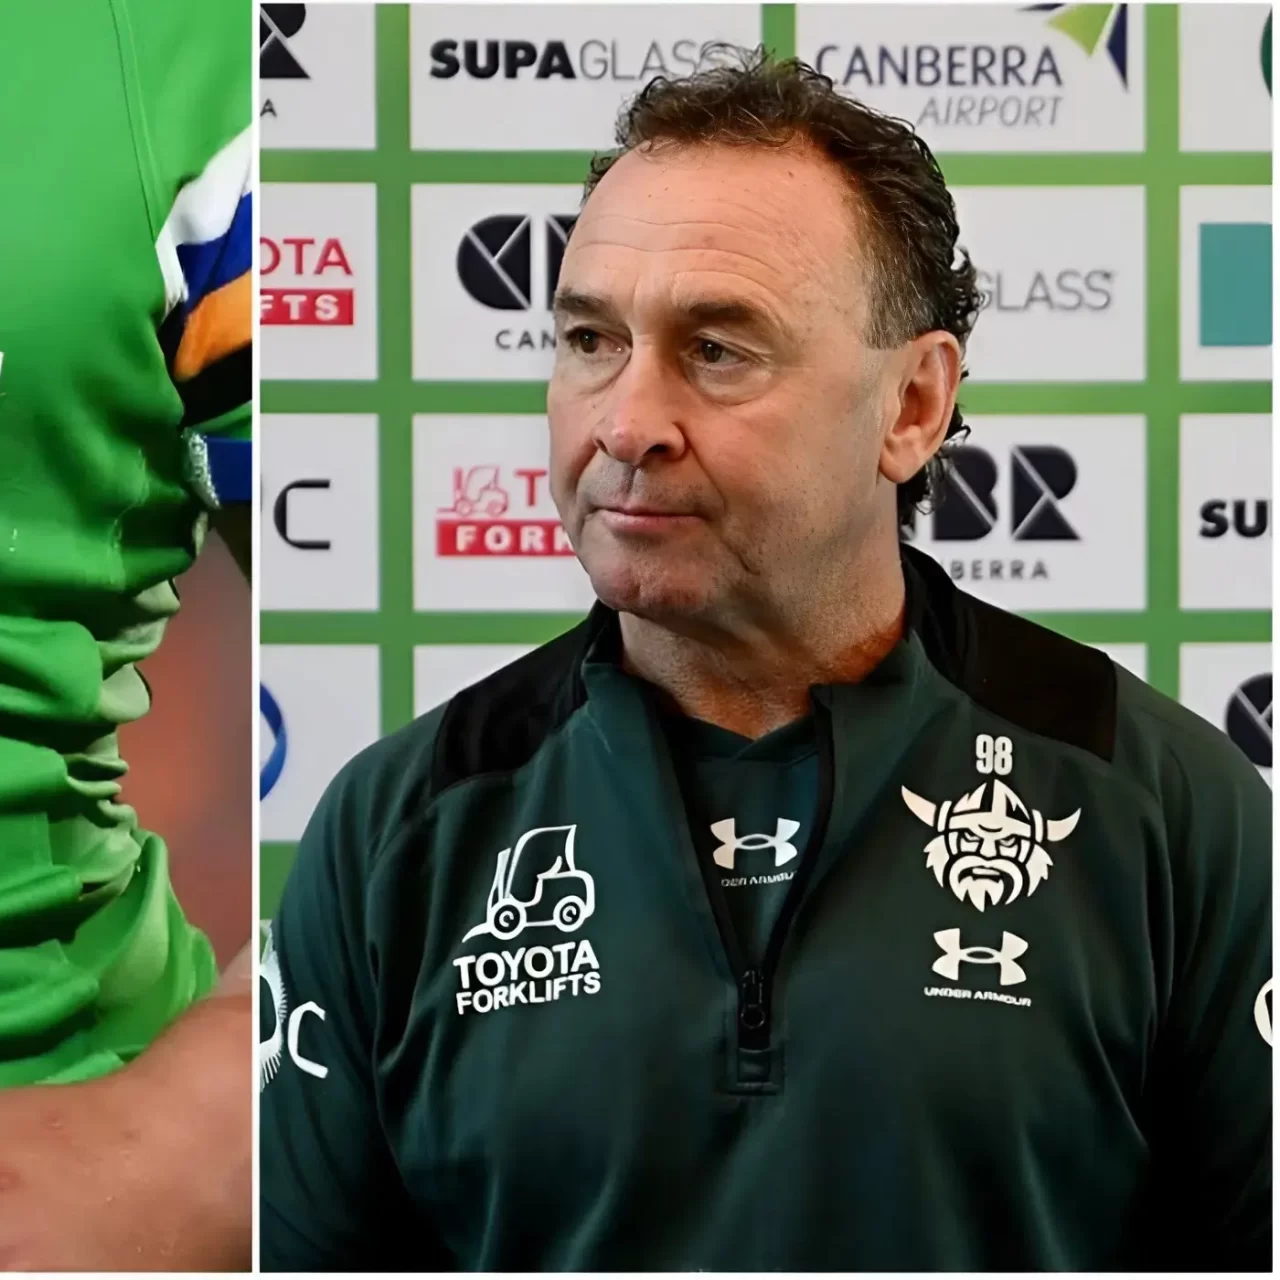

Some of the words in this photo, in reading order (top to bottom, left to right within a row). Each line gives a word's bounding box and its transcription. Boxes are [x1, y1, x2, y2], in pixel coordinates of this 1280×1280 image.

[815, 44, 1063, 86] CANBERRA
[915, 95, 1063, 127] AIRPORT
[976, 734, 1014, 776] 98
[452, 939, 601, 989] TOYOTA
[456, 971, 602, 1015] FORKLIFTS
